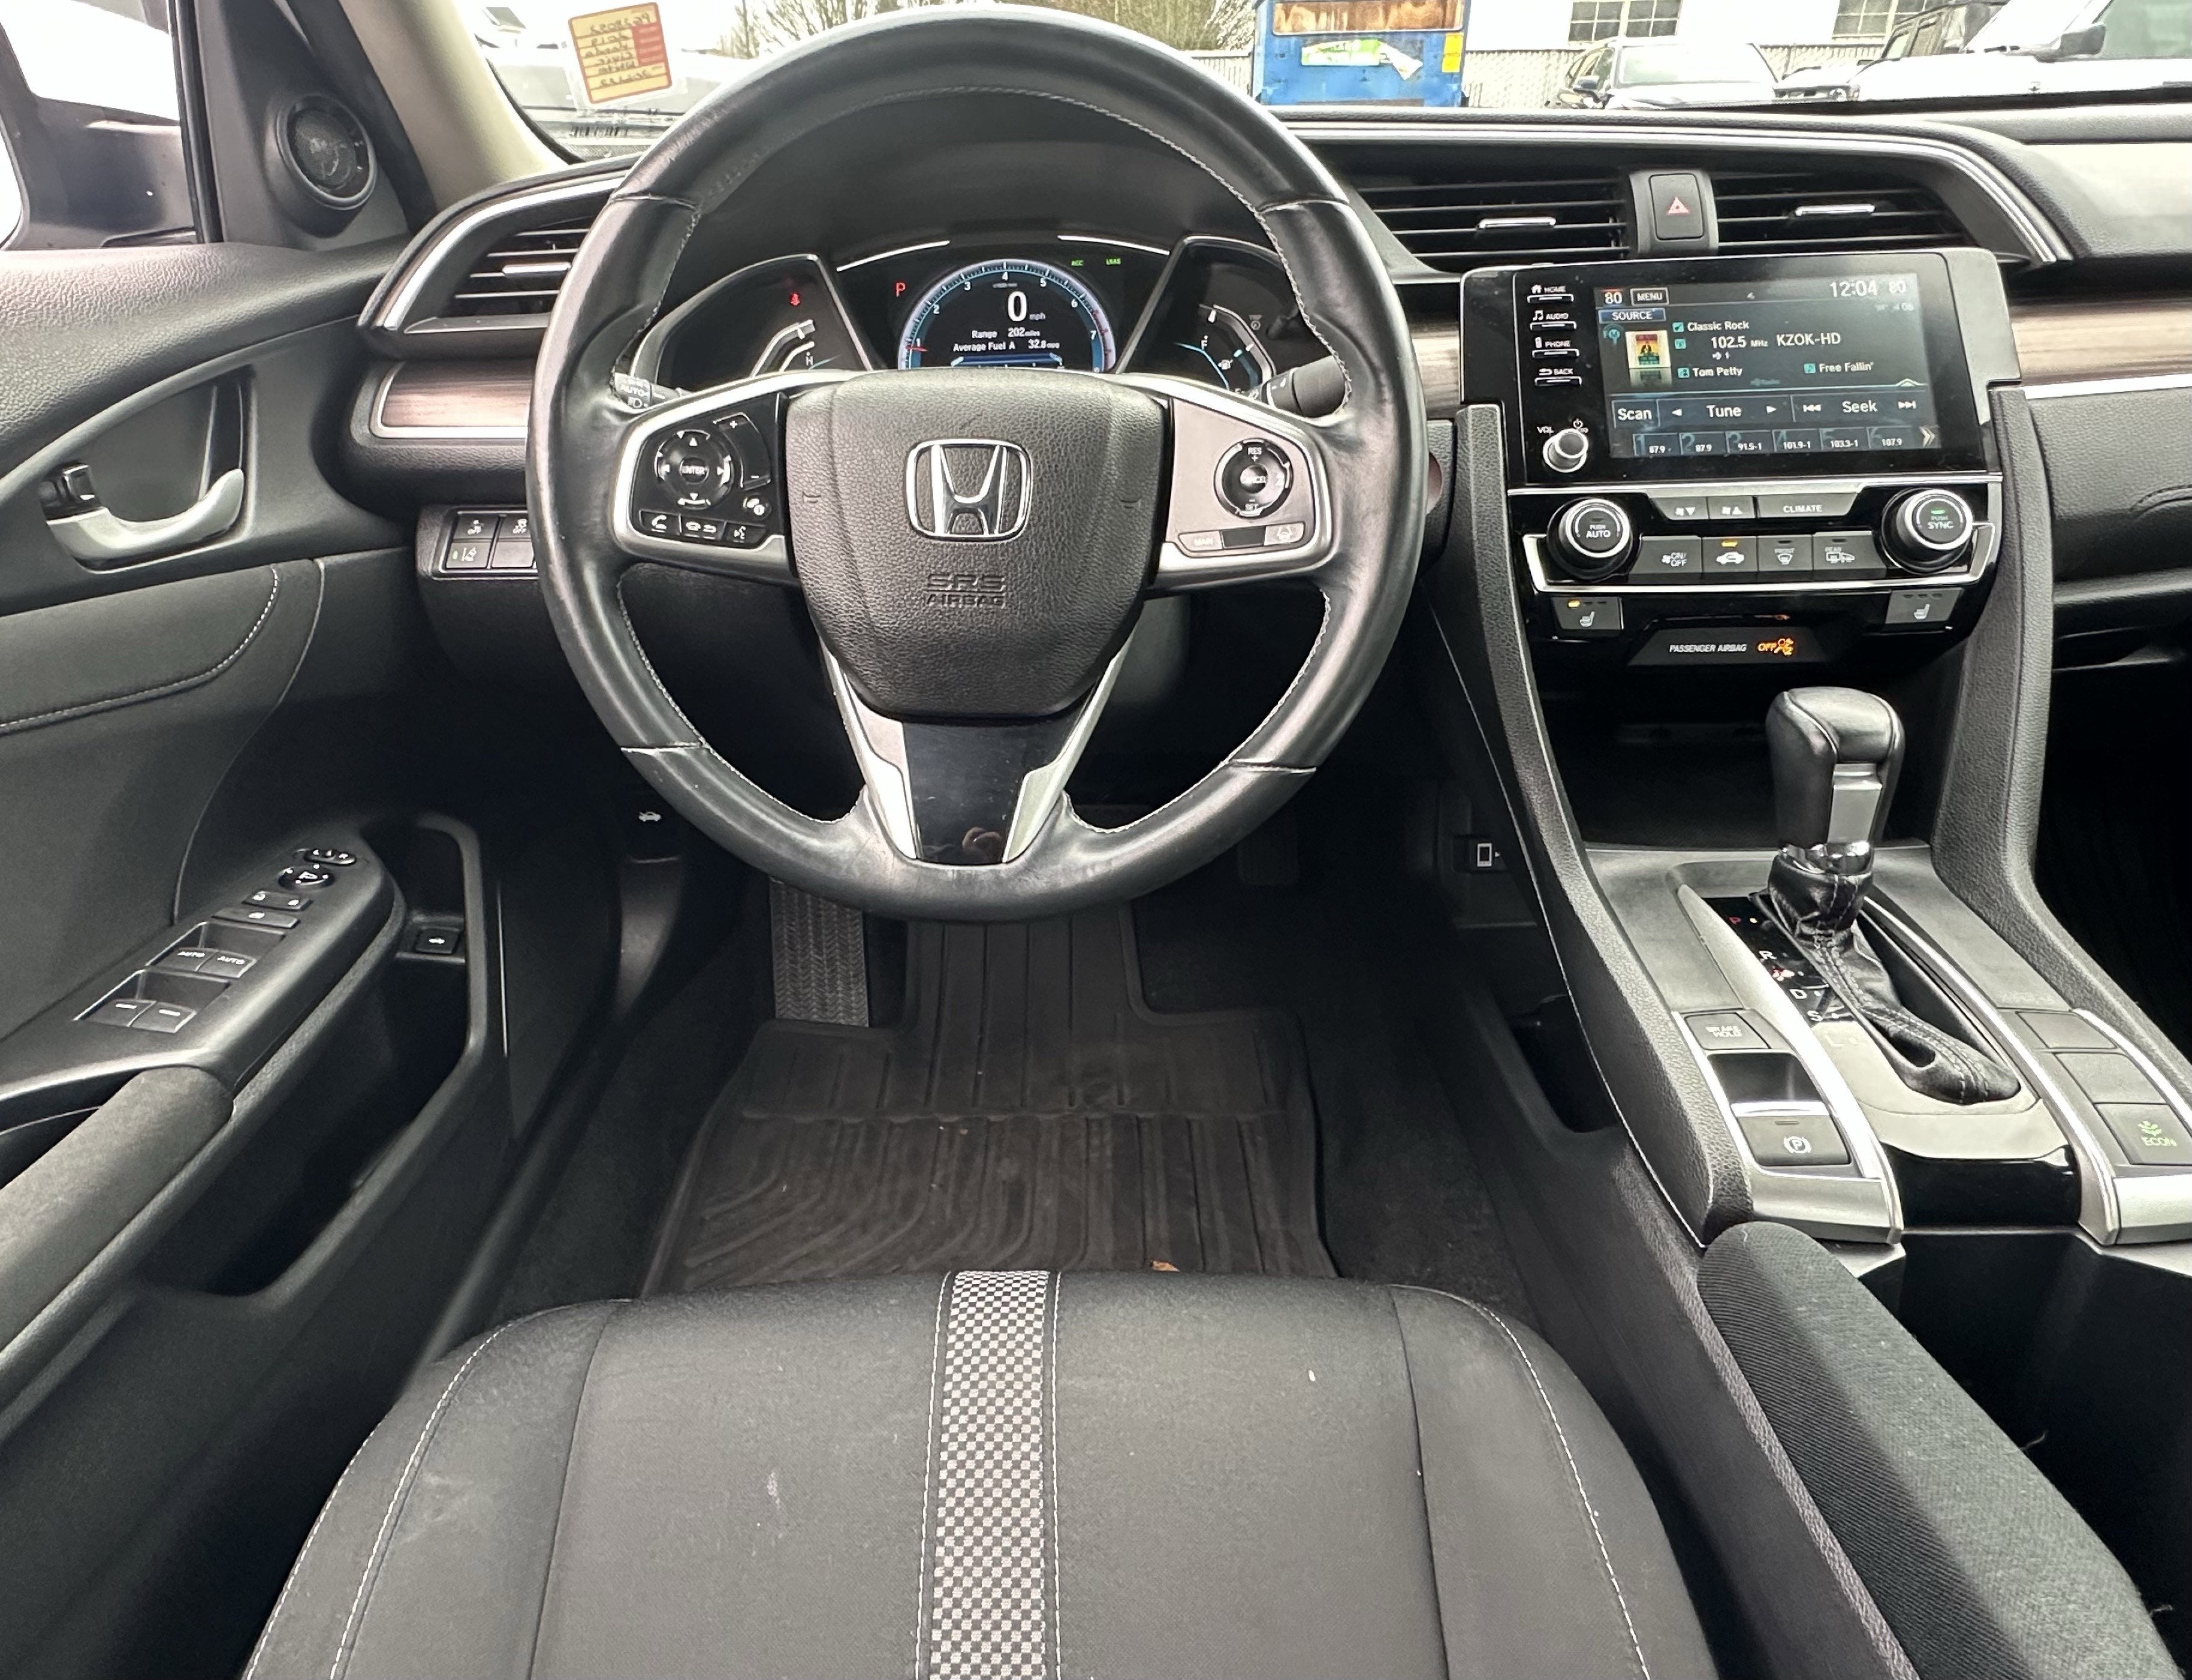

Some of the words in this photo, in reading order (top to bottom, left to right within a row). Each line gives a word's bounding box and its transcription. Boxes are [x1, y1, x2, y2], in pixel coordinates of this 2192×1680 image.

[964, 282, 971, 291] 3
[1040, 279, 1047, 287] 5
[1829, 279, 1878, 297] 12:04
[896, 282, 906, 297] P
[1605, 292, 1623, 304] 80
[1637, 292, 1662, 301] MENU
[1008, 291, 1027, 322] 0
[1029, 312, 1045, 321] mph
[1071, 299, 1078, 307] 6
[933, 304, 940, 314] 2
[1612, 310, 1653, 321] SOURCE
[1687, 321, 1722, 331] Classic
[1724, 320, 1750, 330] Rock
[972, 330, 998, 339] Range
[1008, 327, 1026, 337] 202
[1090, 330, 1096, 340] 7
[916, 338, 921, 347] 1
[1201, 340, 1207, 349] F
[1711, 336, 1747, 349] 102.5
[1776, 332, 1841, 346] KZOK-HD
[953, 343, 986, 352] Average
[988, 342, 1006, 351] Fuel
[806, 355, 813, 366] H
[1692, 367, 1714, 377] Tom
[1716, 366, 1742, 377] Petty
[1819, 363, 1842, 373] Free
[1706, 405, 1742, 418] Tune
[1842, 400, 1877, 414] Seek
[1618, 408, 1652, 421] Scan
[682, 465, 706, 475] ENTER
[1783, 504, 1823, 513] CLIMATE
[1927, 521, 1953, 529] SYNC
[1586, 530, 1611, 538] AUTO
[928, 574, 1006, 591] SRS
[927, 594, 1006, 608] AIRBAG
[1669, 644, 1715, 653] PASSENGER
[1717, 644, 1747, 652] AIRBAG
[1757, 643, 1777, 652] OFF
[217, 956, 245, 964] AUTO
[1759, 950, 1777, 960] R
[1789, 988, 1807, 999] D
[1807, 1010, 1823, 1022] S
[2141, 1137, 2178, 1147] ECON
